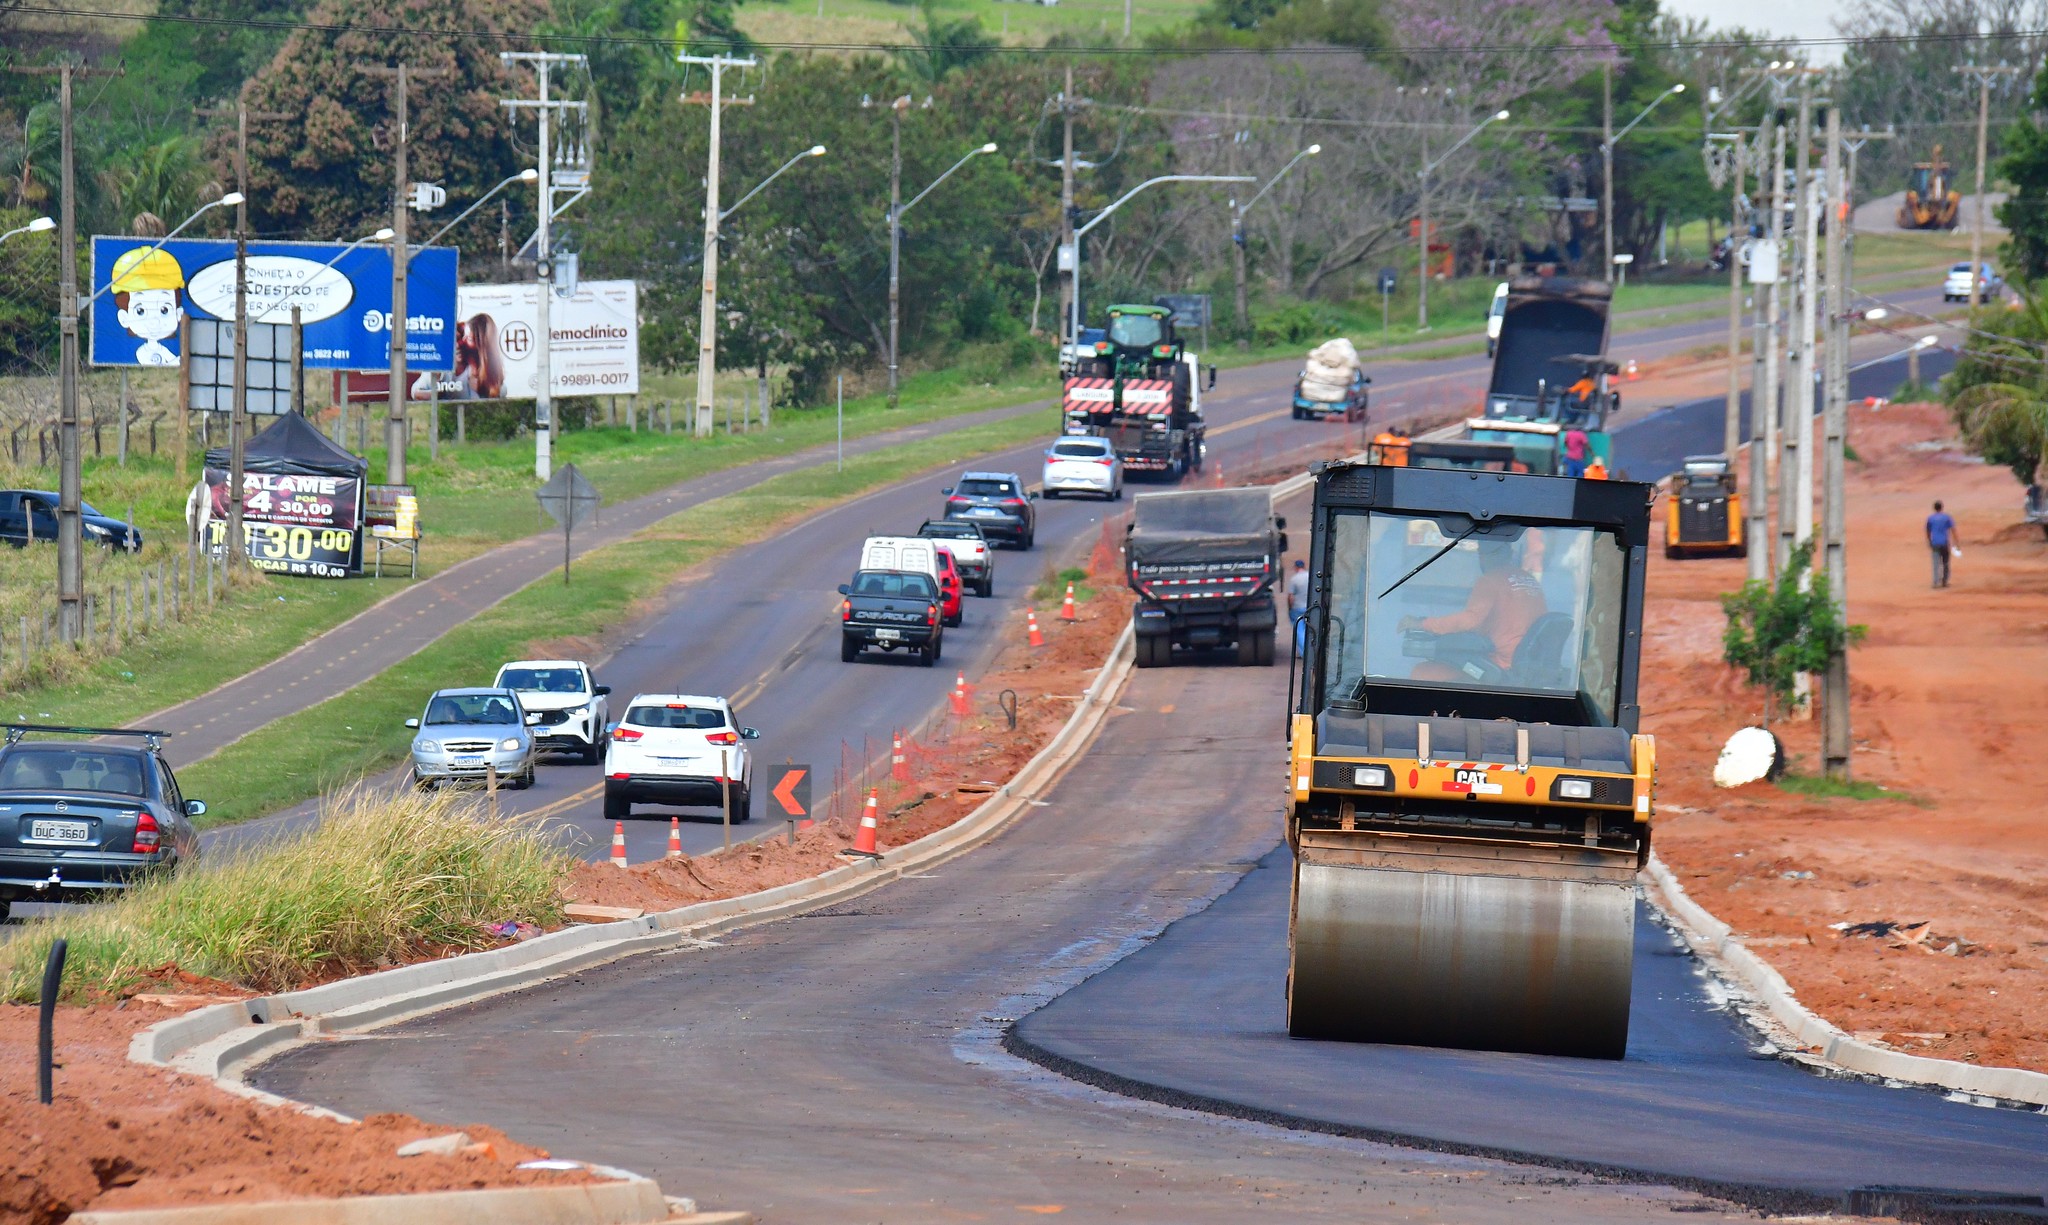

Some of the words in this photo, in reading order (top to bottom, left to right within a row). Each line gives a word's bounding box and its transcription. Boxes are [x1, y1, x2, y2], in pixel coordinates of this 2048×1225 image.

[254, 284, 312, 296] DESTRO
[315, 286, 329, 295] DE
[385, 313, 444, 332] Dstro
[549, 324, 628, 341] emoclínico
[247, 490, 273, 513] 4
[295, 495, 318, 503] POR
[279, 501, 334, 516] 30,00
[1456, 770, 1488, 785] CAT
